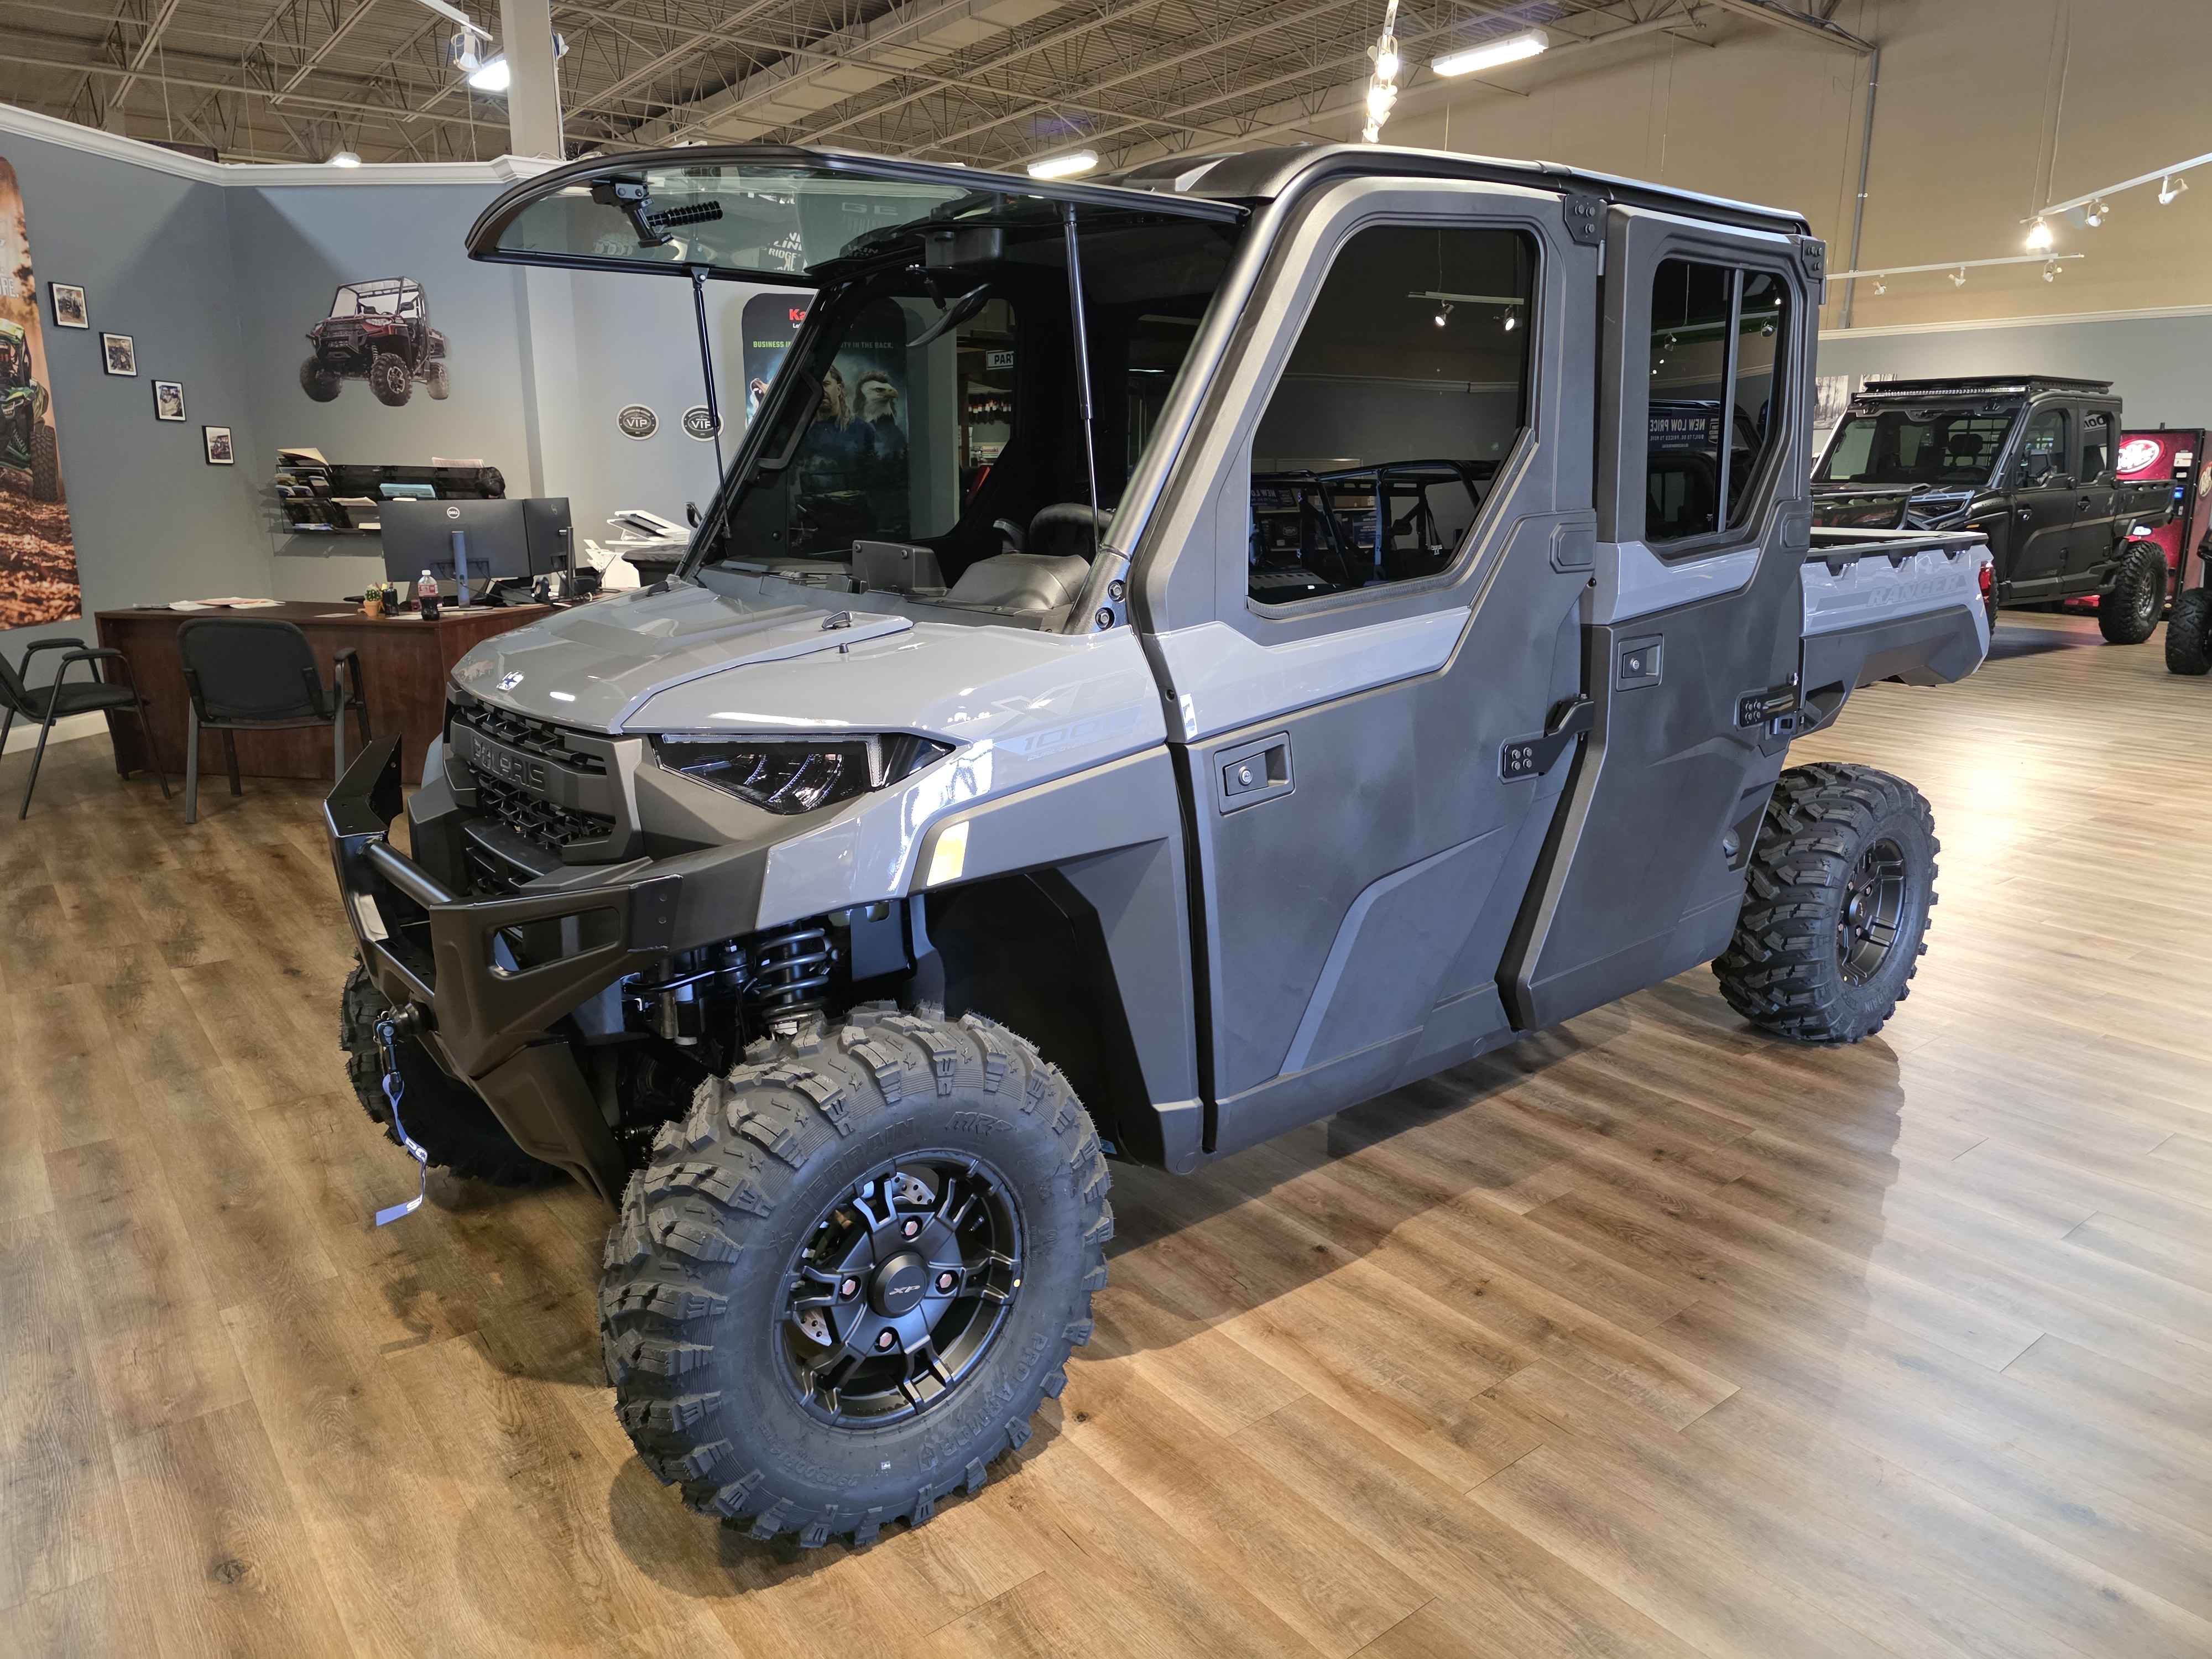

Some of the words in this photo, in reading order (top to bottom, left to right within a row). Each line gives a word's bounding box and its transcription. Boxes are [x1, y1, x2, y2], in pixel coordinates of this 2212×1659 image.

[994, 353, 1013, 364] PAR
[626, 419, 647, 427] VIP
[1866, 573, 1960, 607] RANGER
[1024, 709, 1133, 752] 1000
[473, 736, 546, 792] POLARIS
[889, 1285, 921, 1296] XP
